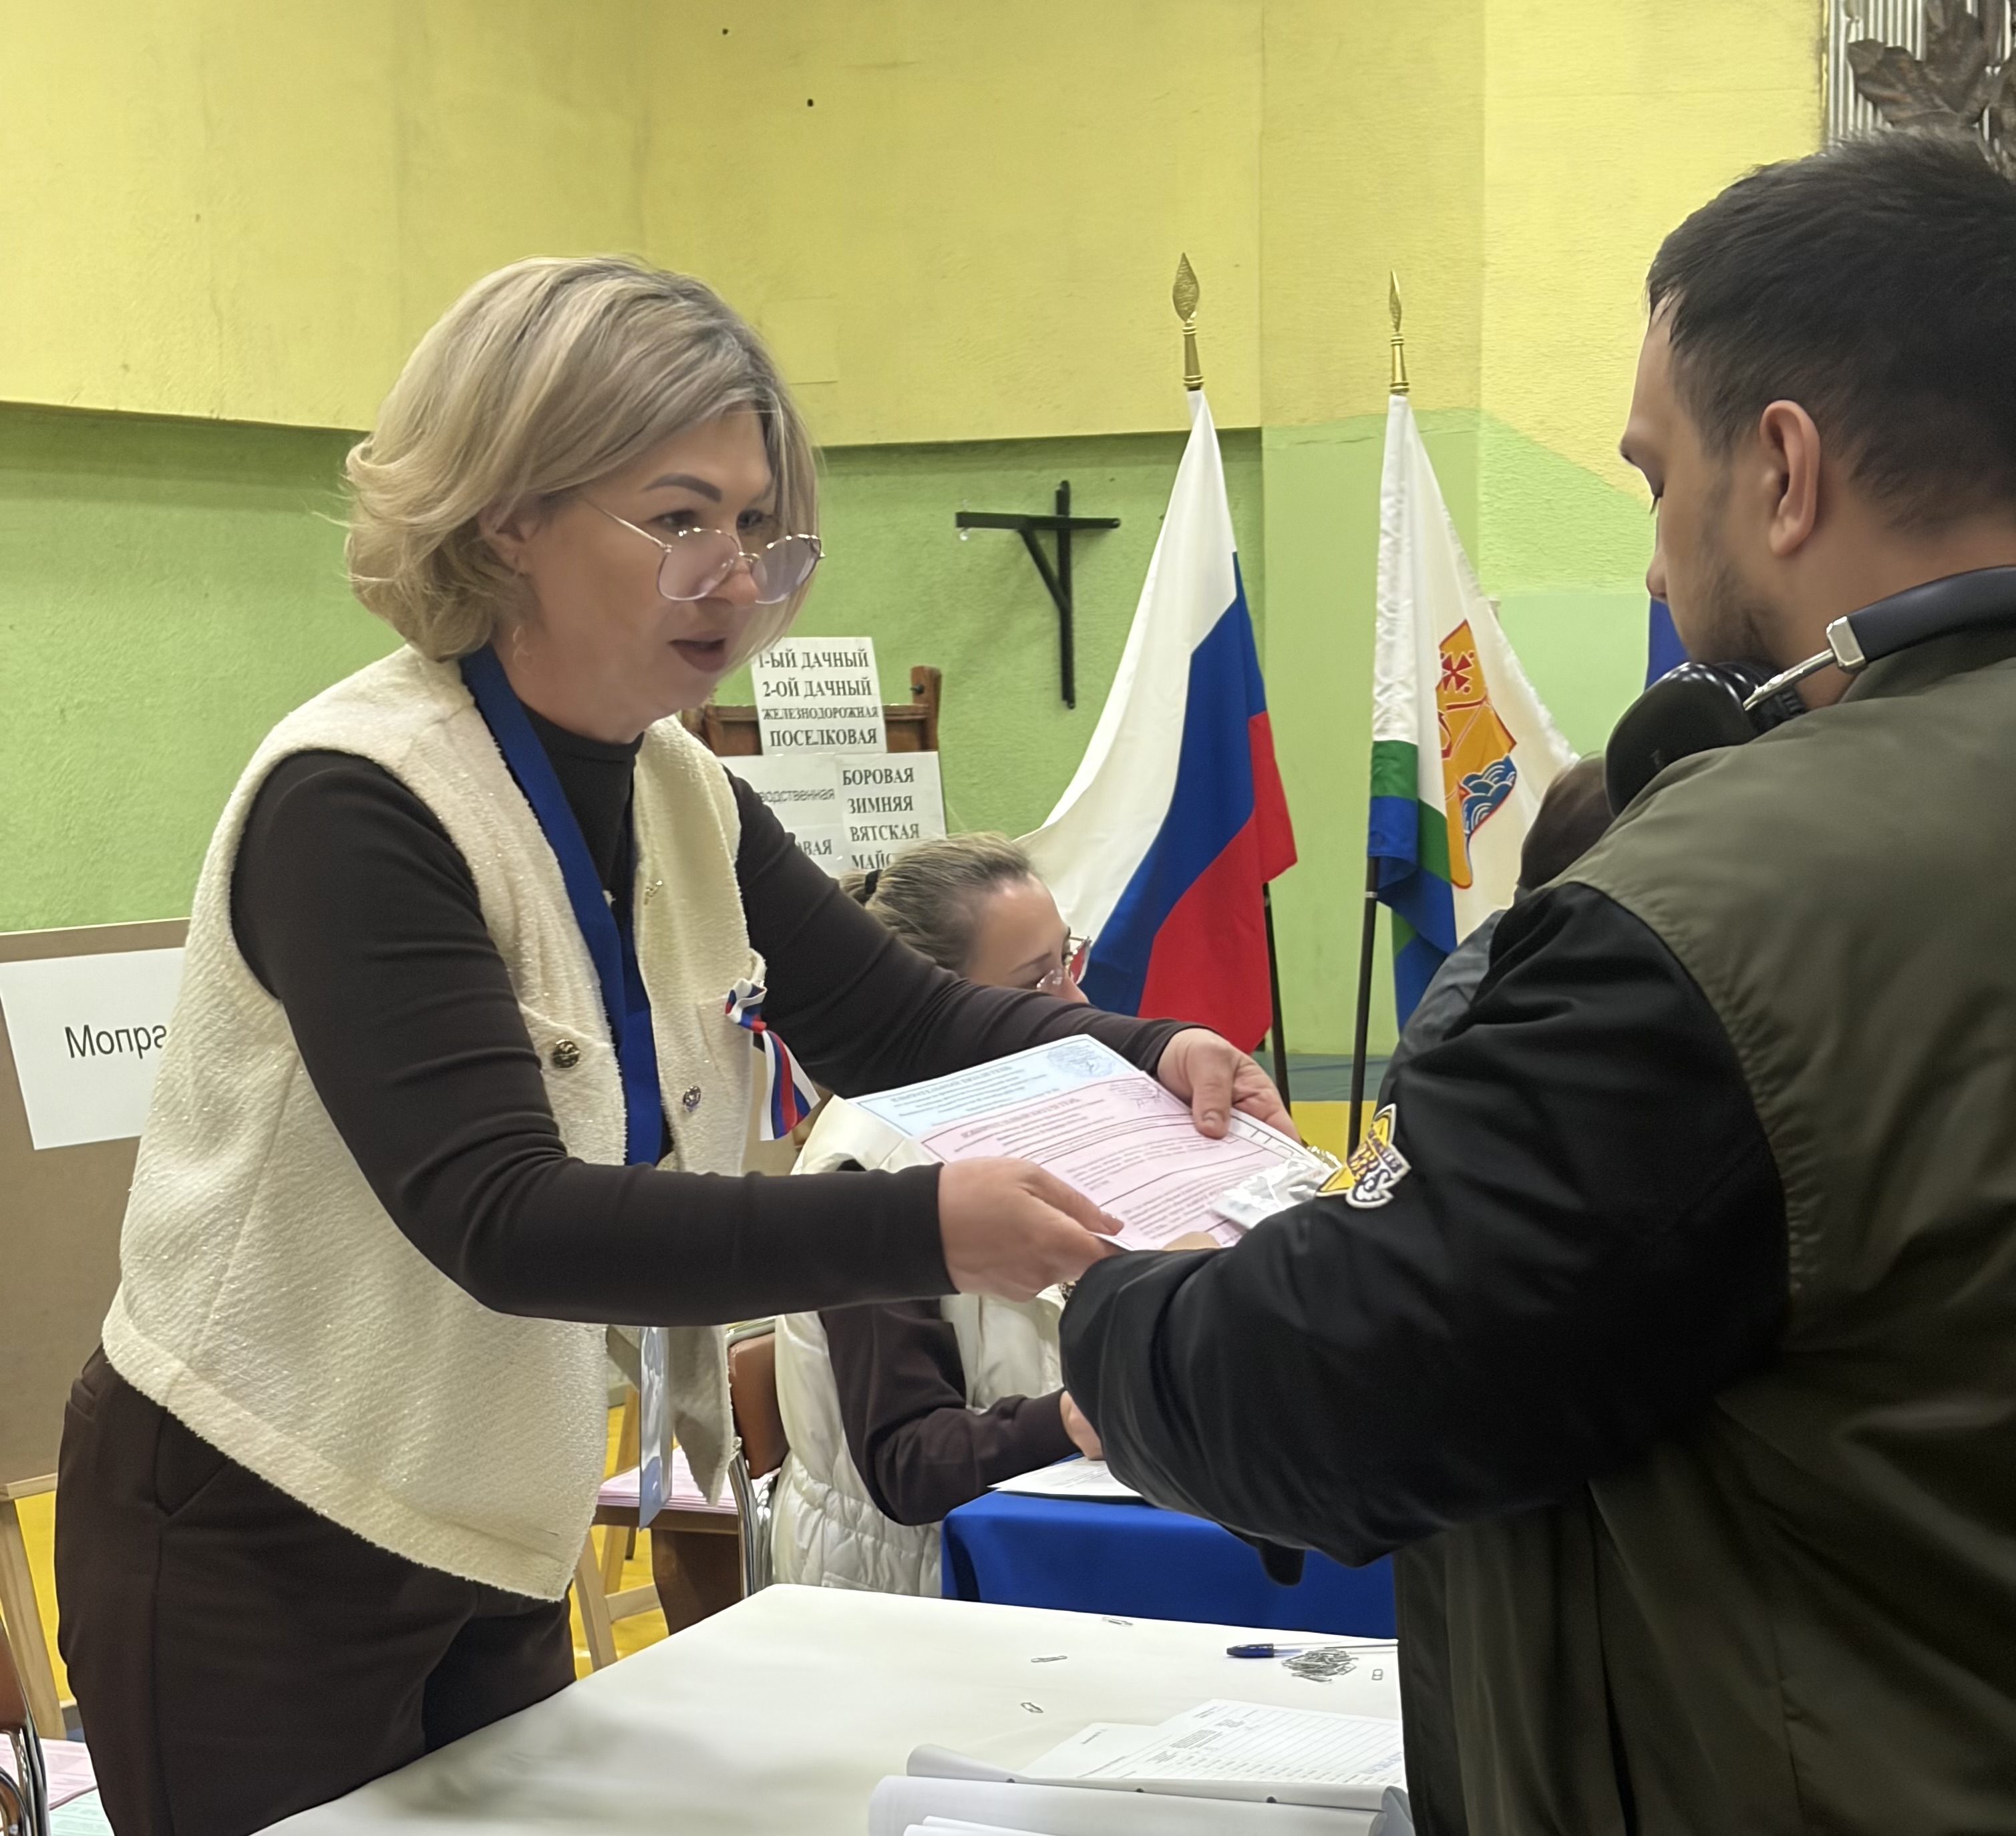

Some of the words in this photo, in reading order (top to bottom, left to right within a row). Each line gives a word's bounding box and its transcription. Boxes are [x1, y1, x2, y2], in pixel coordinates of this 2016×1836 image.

[759, 649, 798, 668] 1-ЫЙ
[802, 649, 870, 670] ДАЧНЫЙ
[762, 677, 800, 697] 2-ОЙ
[804, 677, 872, 698] ДАЧНЫЙ
[762, 707, 879, 720] ЖЕЛЕЗНОДОРОЖНАЯ
[770, 728, 877, 747] ПОСЕЛКОВАЯ
[842, 767, 914, 785] БОРОВАЯ
[847, 795, 913, 814] ЗИМНЯЯ
[850, 823, 920, 842] ВЯТСКАЯ
